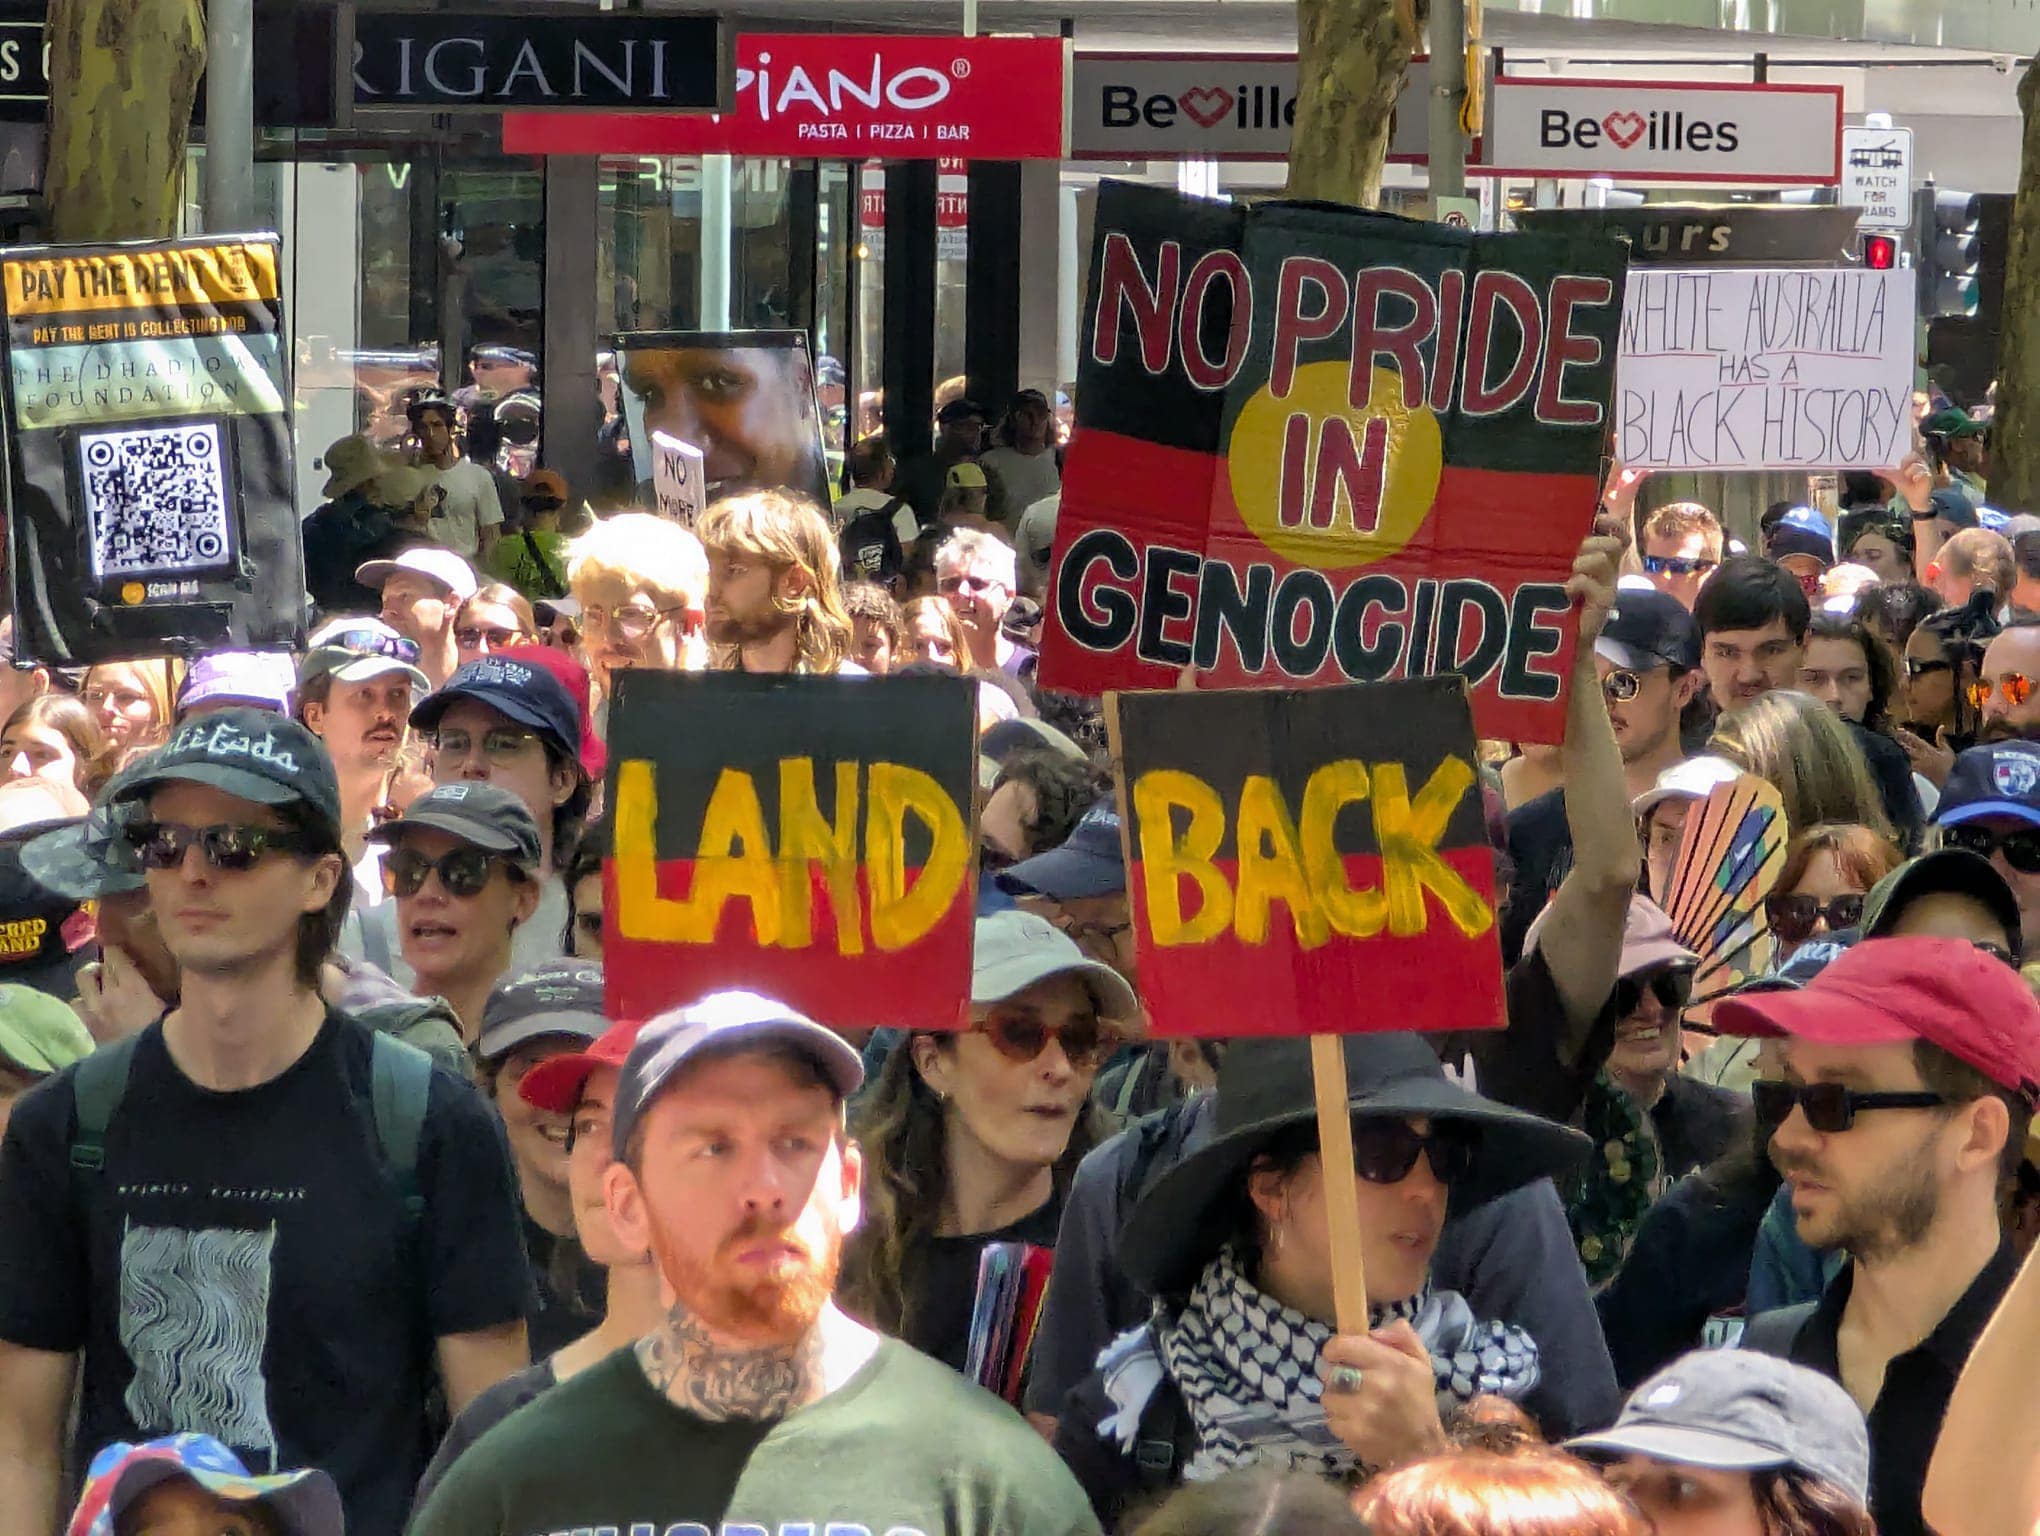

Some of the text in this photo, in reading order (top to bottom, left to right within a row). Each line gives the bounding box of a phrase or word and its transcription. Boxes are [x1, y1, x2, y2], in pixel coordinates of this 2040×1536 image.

[798, 124, 970, 140] PASTA PIZZA BAR
[1855, 176, 1897, 187] WATCH
[1864, 191, 1887, 202] FOR
[1863, 206, 1897, 218] RAMS
[21, 262, 67, 302] PAY
[74, 262, 127, 299] THE
[1093, 232, 1613, 425] NO PRIDE
[1622, 271, 1887, 353] WHITE AUSTRALIA
[33, 325, 57, 345] PAY
[61, 324, 85, 343] THE
[1718, 353, 1799, 383] HAS A
[27, 381, 239, 411] FOUNDATION
[1623, 385, 1910, 465] BLACK HISTORY
[663, 451, 688, 486] NO
[1278, 413, 1389, 534] IN
[1057, 528, 1573, 701] GENOCIDE
[614, 755, 971, 957] LAND
[1133, 753, 1494, 951] BACK
